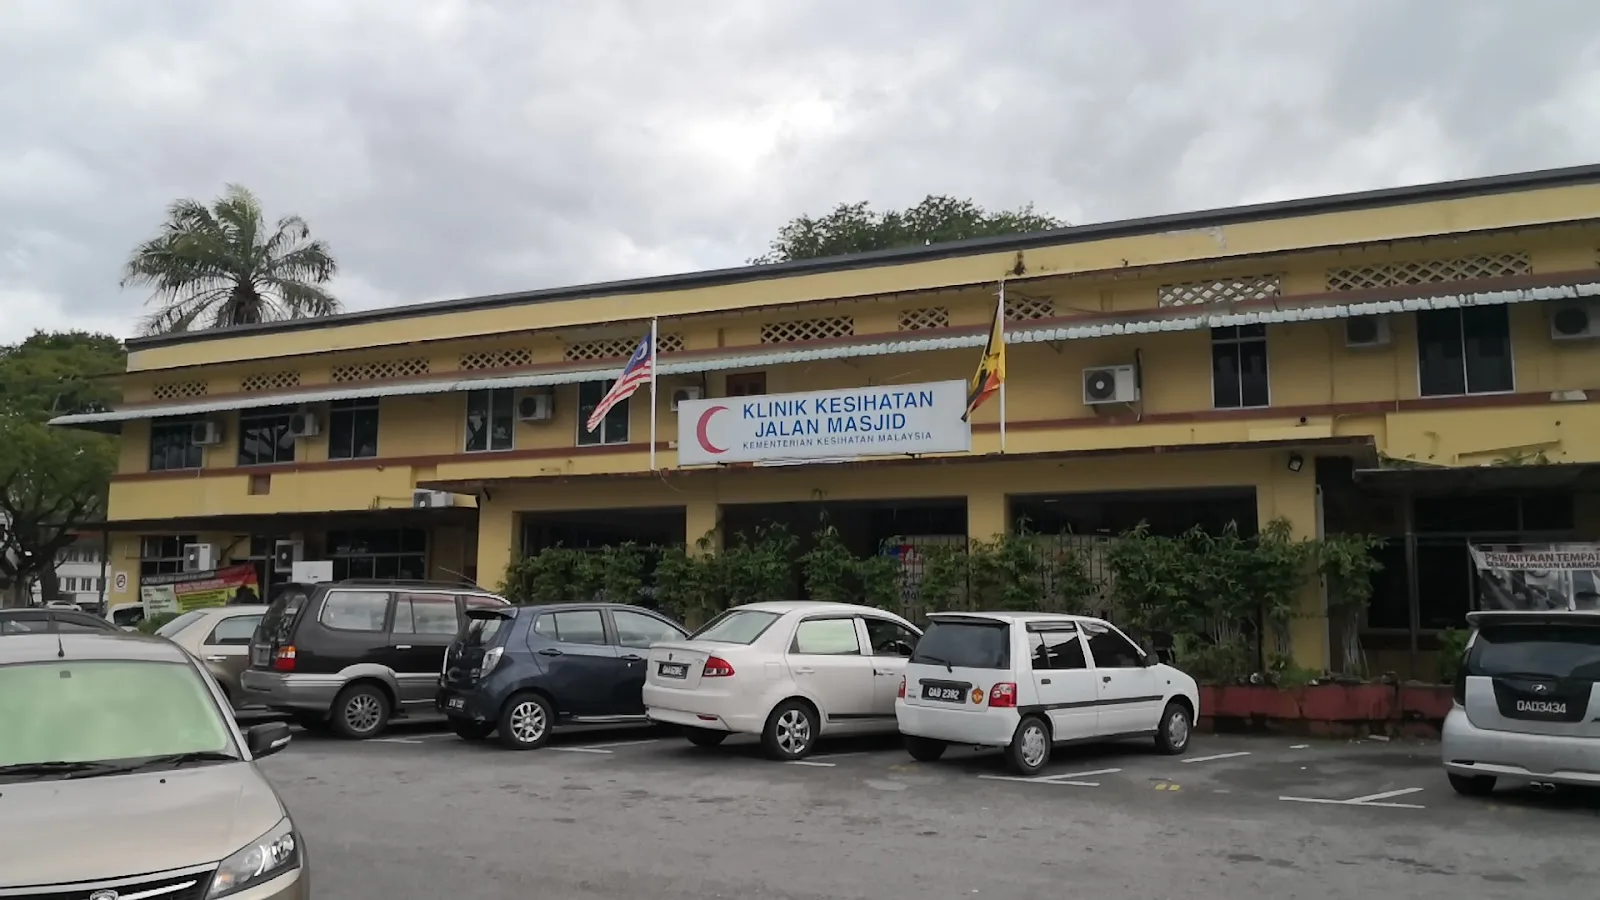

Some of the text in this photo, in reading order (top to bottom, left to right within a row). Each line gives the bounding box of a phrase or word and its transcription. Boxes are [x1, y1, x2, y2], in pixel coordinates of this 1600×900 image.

[743, 390, 933, 419] KLINIK KESIHATAN
[755, 413, 906, 437] JALAN MASJID
[743, 432, 932, 450] KEMENTERIAN KESIHATAN MALAYSIA
[1484, 552, 1554, 562] PEWARTAAN
[1520, 561, 1560, 569] KAWASAN
